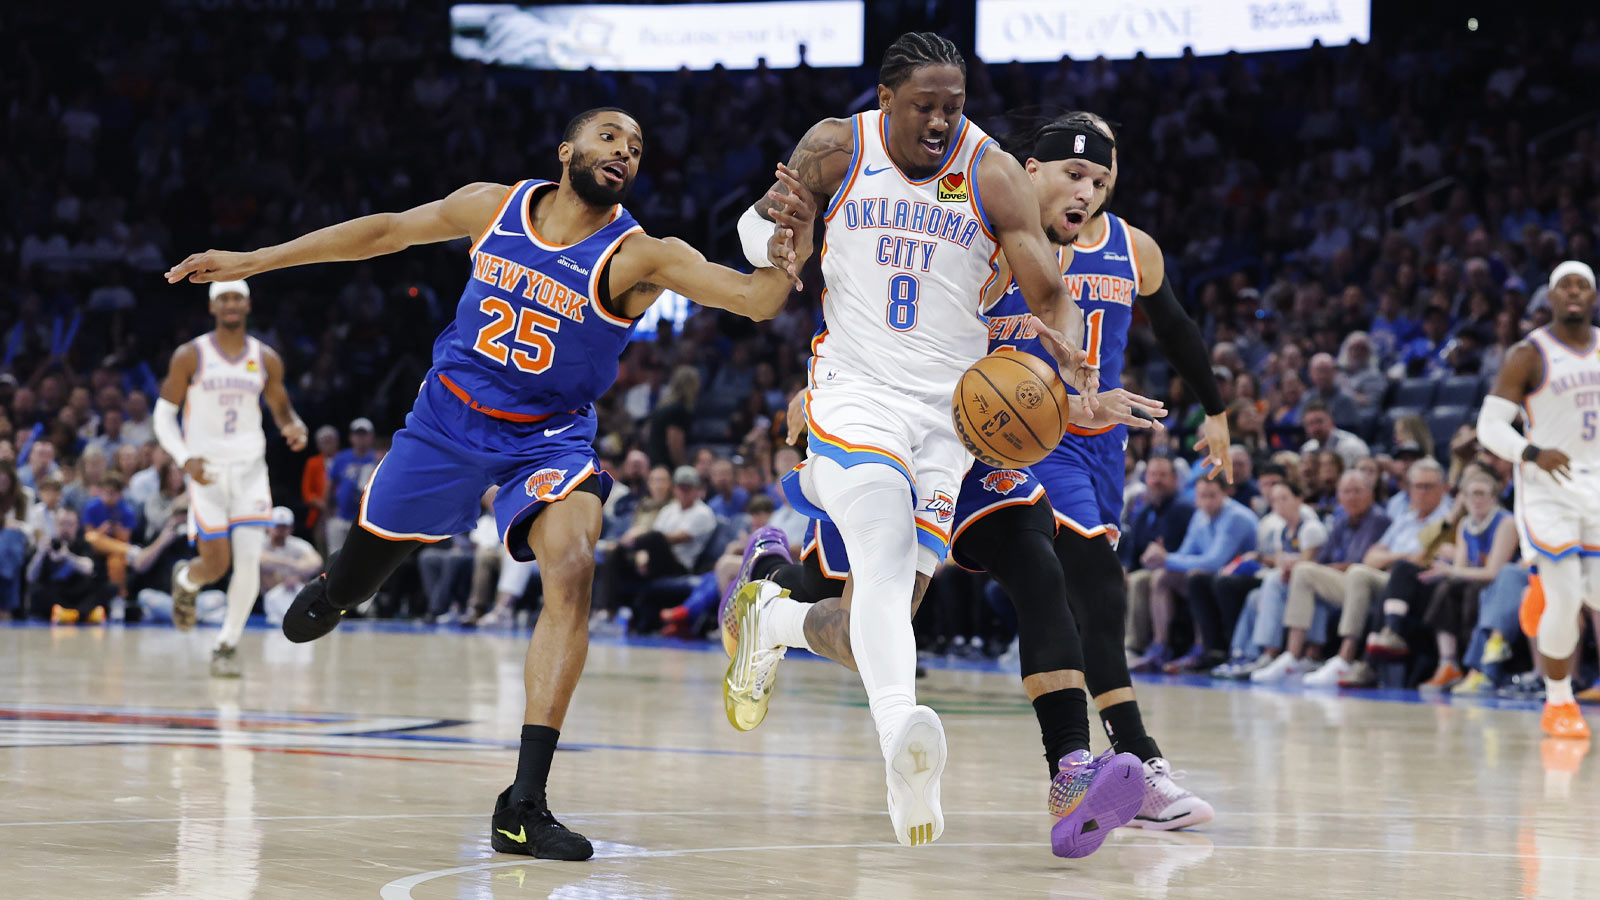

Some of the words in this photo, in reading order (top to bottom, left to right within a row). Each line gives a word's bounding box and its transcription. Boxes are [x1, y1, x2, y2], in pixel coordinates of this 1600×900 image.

[1002, 10, 1079, 43] ONE
[1125, 5, 1200, 38] ONE
[843, 197, 982, 250] OKLAHOMA
[875, 234, 937, 273] CITY
[473, 250, 525, 294] NEW
[522, 270, 589, 324] YORK
[886, 272, 920, 332] 8
[1086, 273, 1135, 308] YORK
[473, 296, 561, 375] 25
[224, 409, 238, 434] 2
[1582, 410, 1598, 441] 5
[528, 470, 563, 493] KNICKS
[985, 471, 1026, 488] KNICKS
